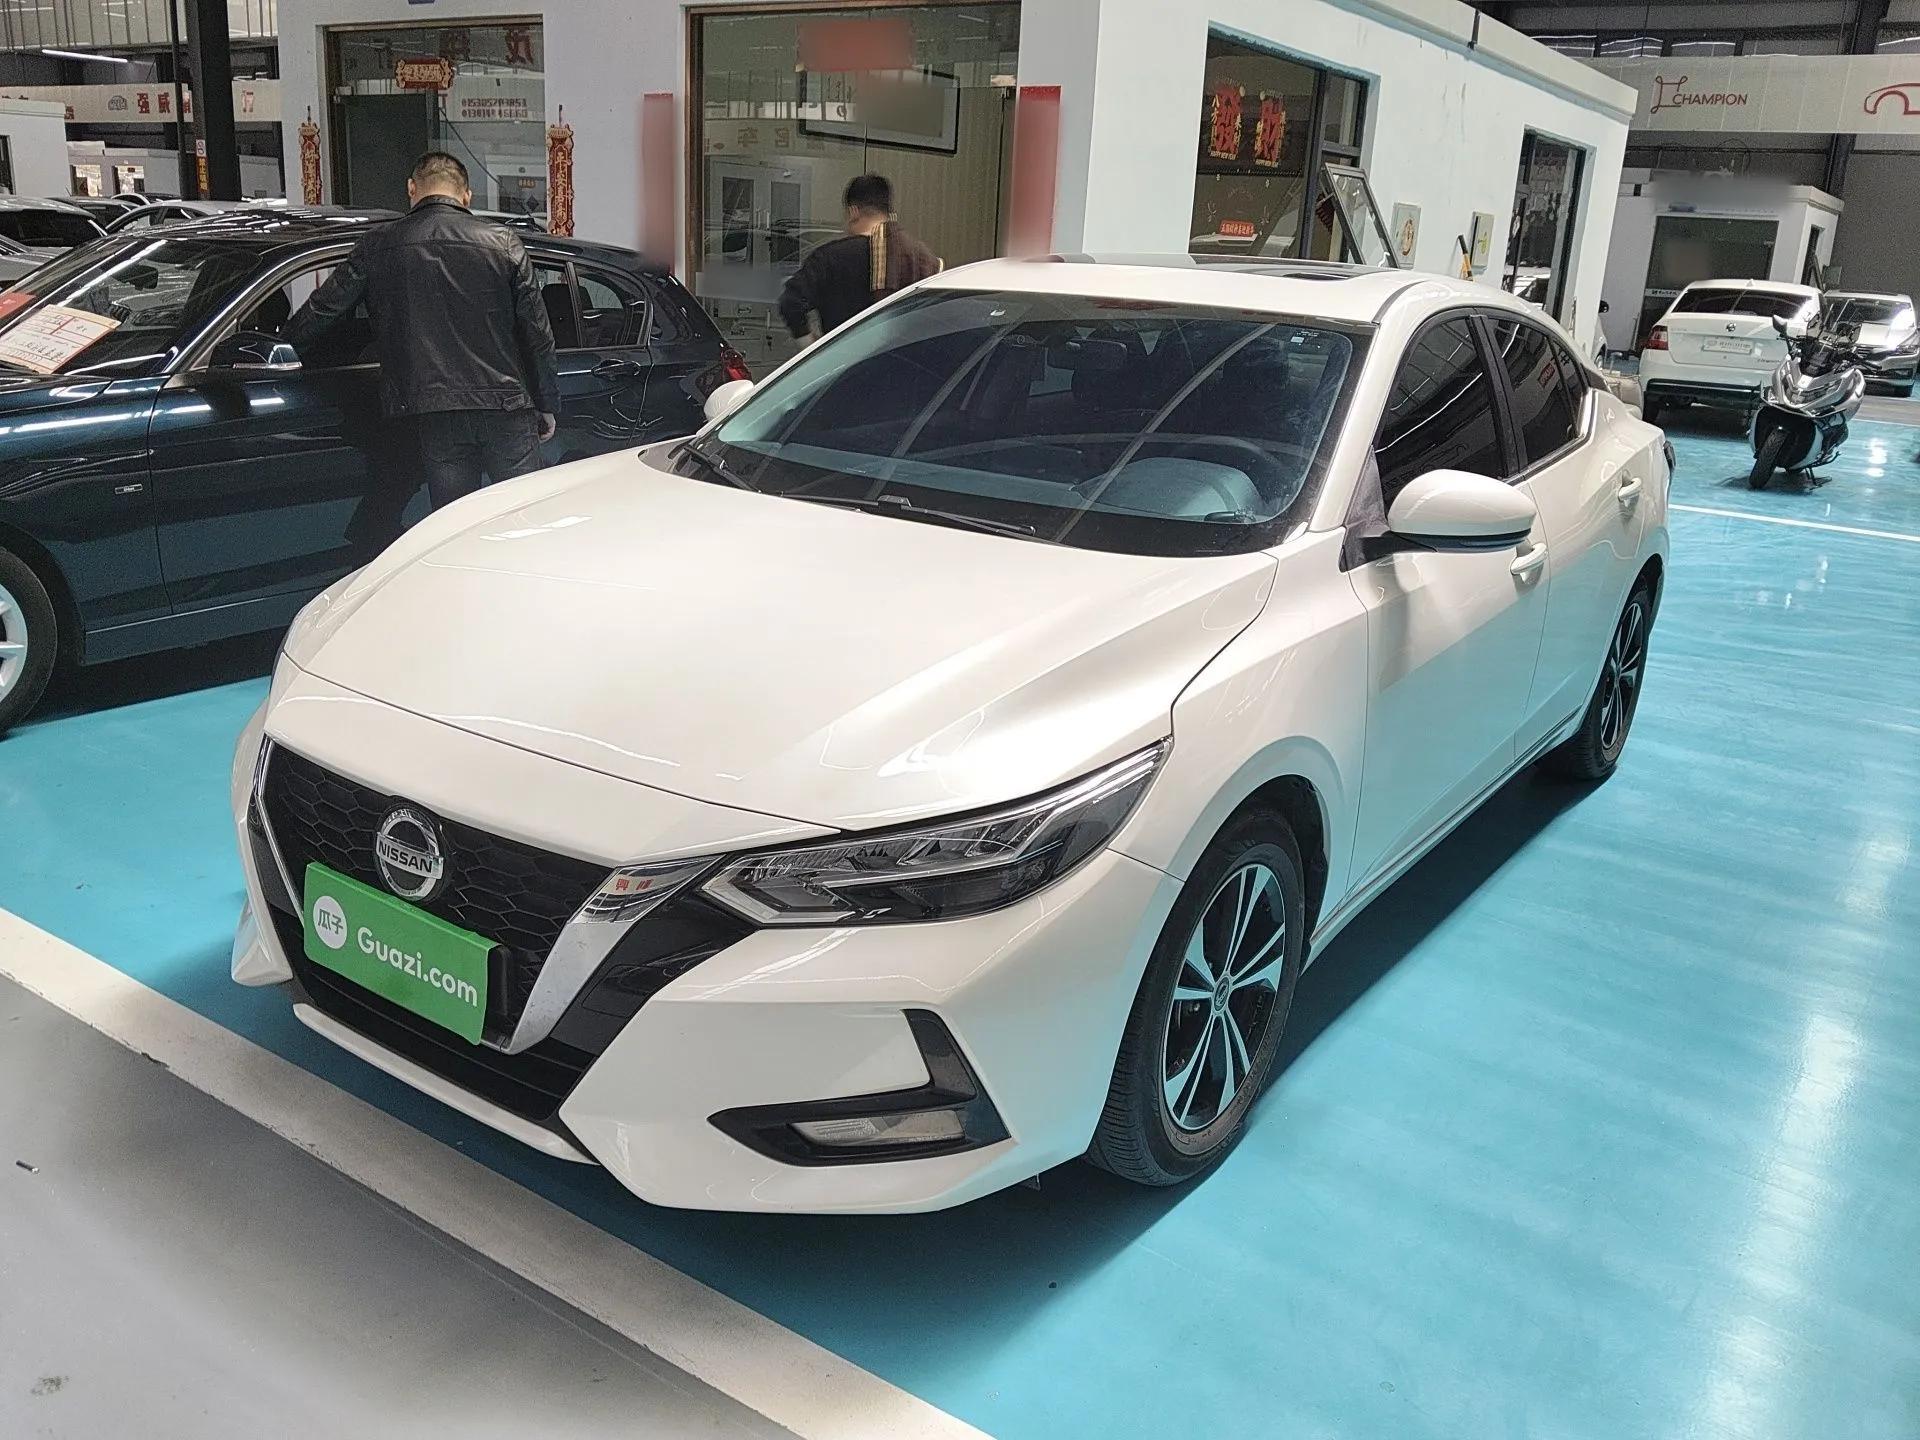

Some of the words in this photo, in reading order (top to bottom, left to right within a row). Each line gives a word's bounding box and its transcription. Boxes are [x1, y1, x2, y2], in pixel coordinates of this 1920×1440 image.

[1672, 93, 1748, 106] CHAMPION
[378, 840, 433, 874] NISSAN
[317, 908, 344, 935] 瓜子
[357, 927, 478, 1008] Guazi.com
